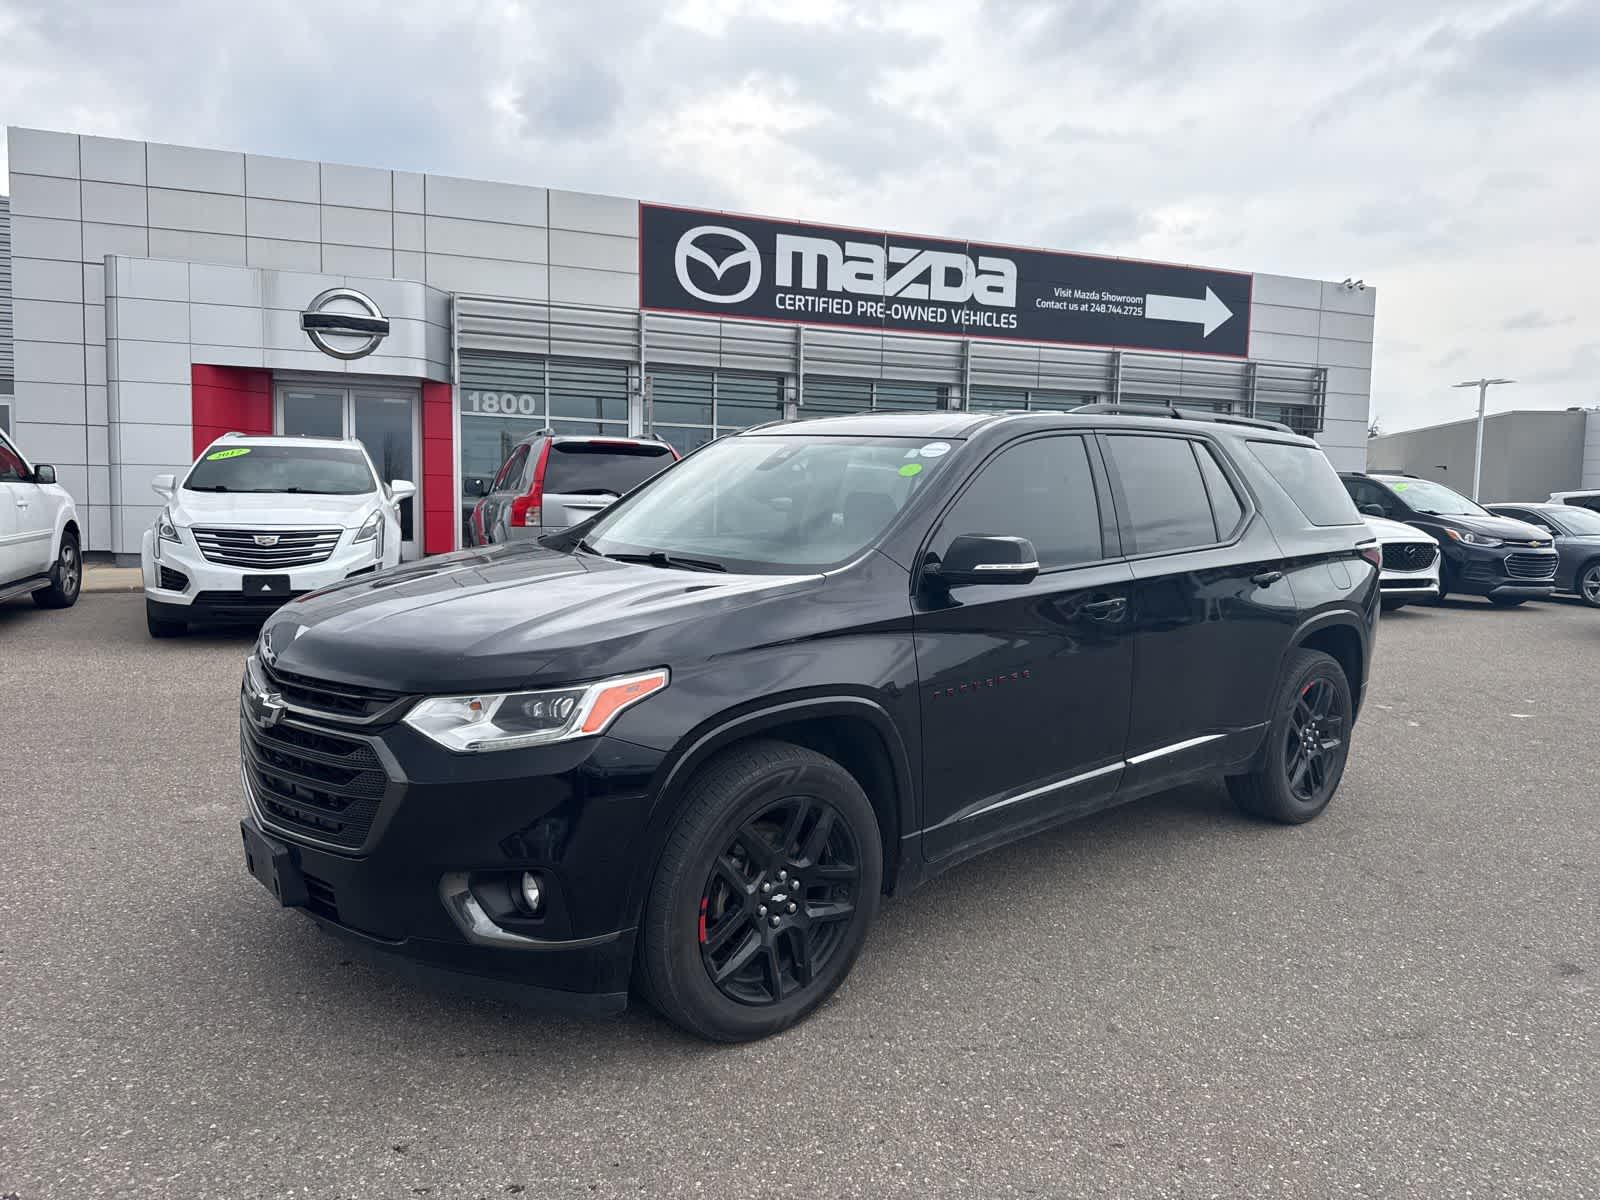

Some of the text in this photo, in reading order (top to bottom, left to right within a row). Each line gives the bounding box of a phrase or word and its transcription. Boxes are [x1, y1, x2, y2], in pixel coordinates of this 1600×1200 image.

[1054, 287, 1143, 304] Visit Mazda Showroom
[775, 293, 1018, 329] CERTIFIED PRE-OWNED VEHICLES
[1035, 298, 1143, 316] Contact us at 248.744.2725
[468, 391, 536, 415] 1800
